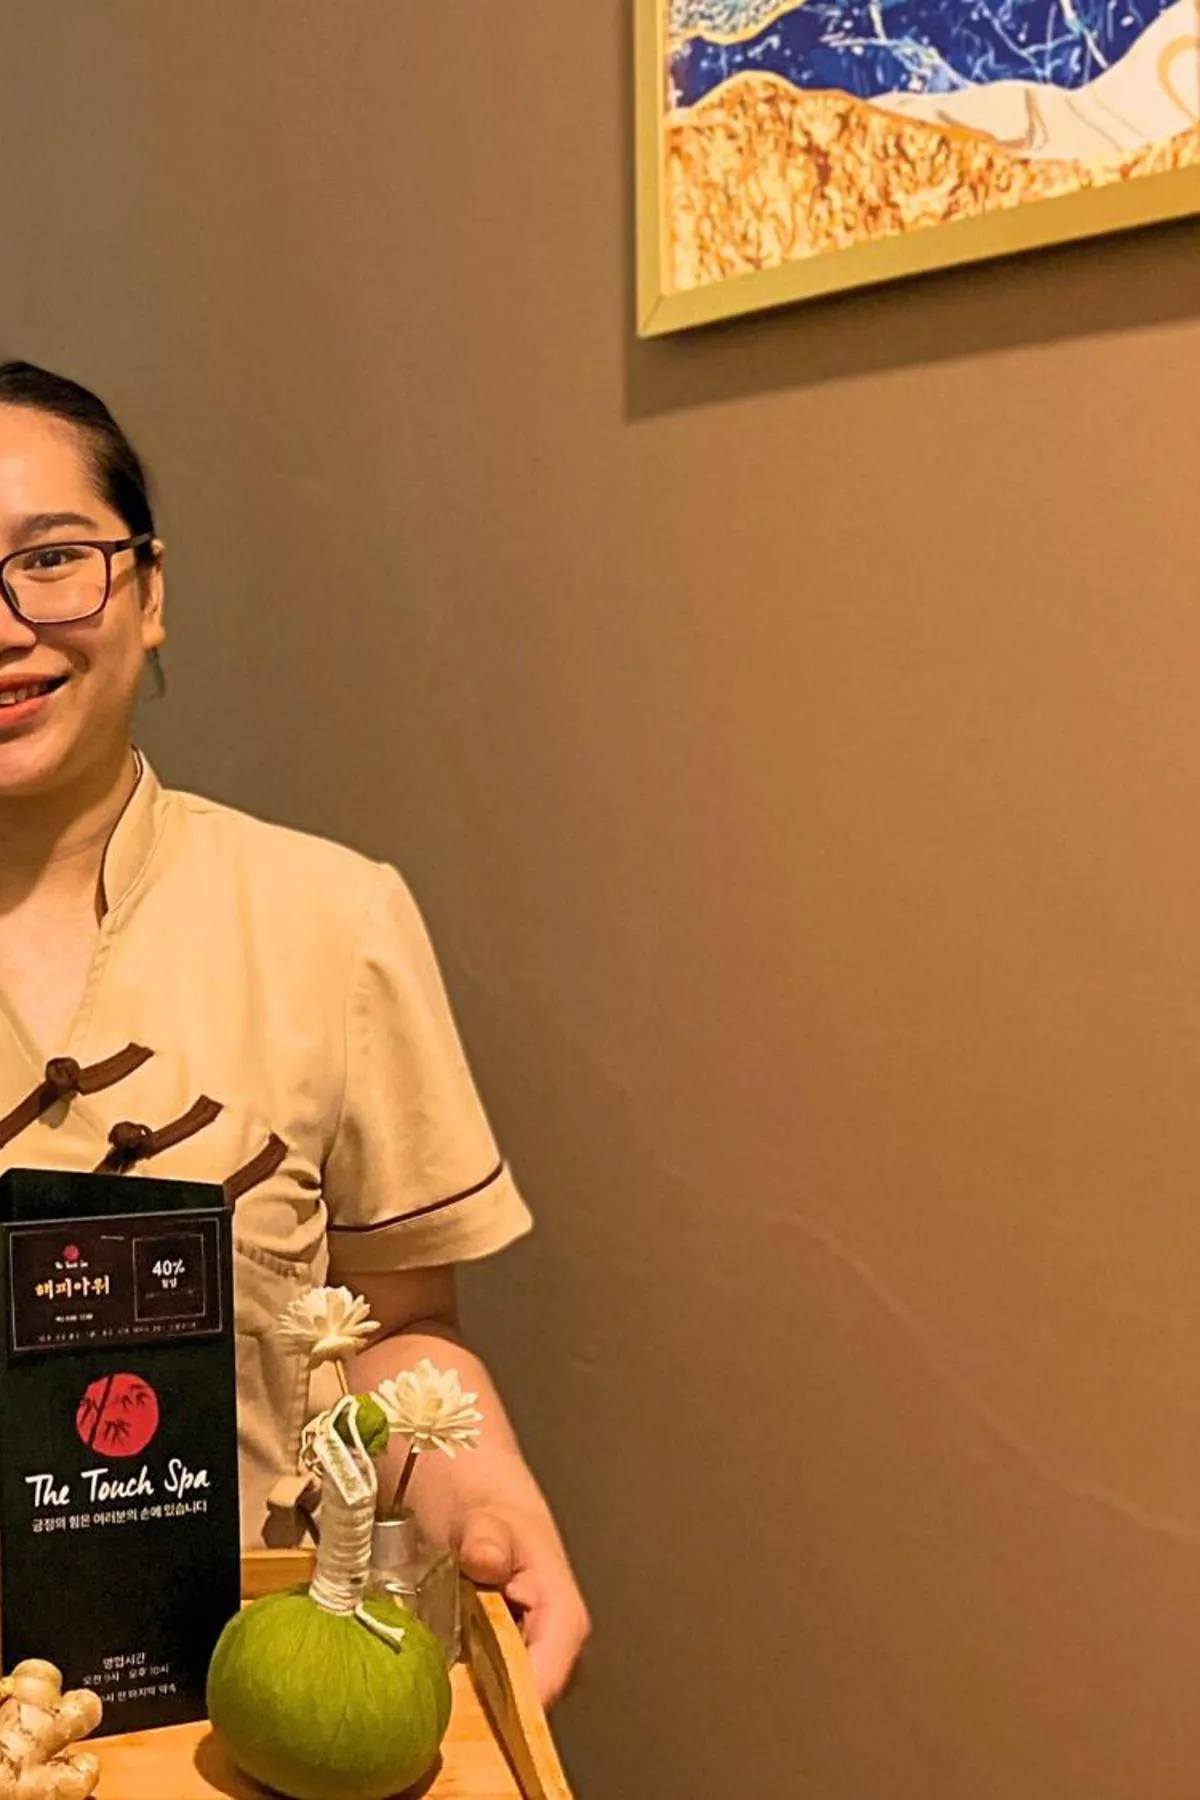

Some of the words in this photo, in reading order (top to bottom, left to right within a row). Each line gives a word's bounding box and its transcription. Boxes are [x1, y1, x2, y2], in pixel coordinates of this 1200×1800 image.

[152, 1258, 186, 1277] 40%
[25, 1474, 71, 1508] The
[80, 1465, 155, 1503] Touch
[164, 1458, 211, 1499] Spa
[93, 1508, 138, 1527] 여러분의
[140, 1505, 162, 1521] 손에
[164, 1499, 208, 1517] 있습니다
